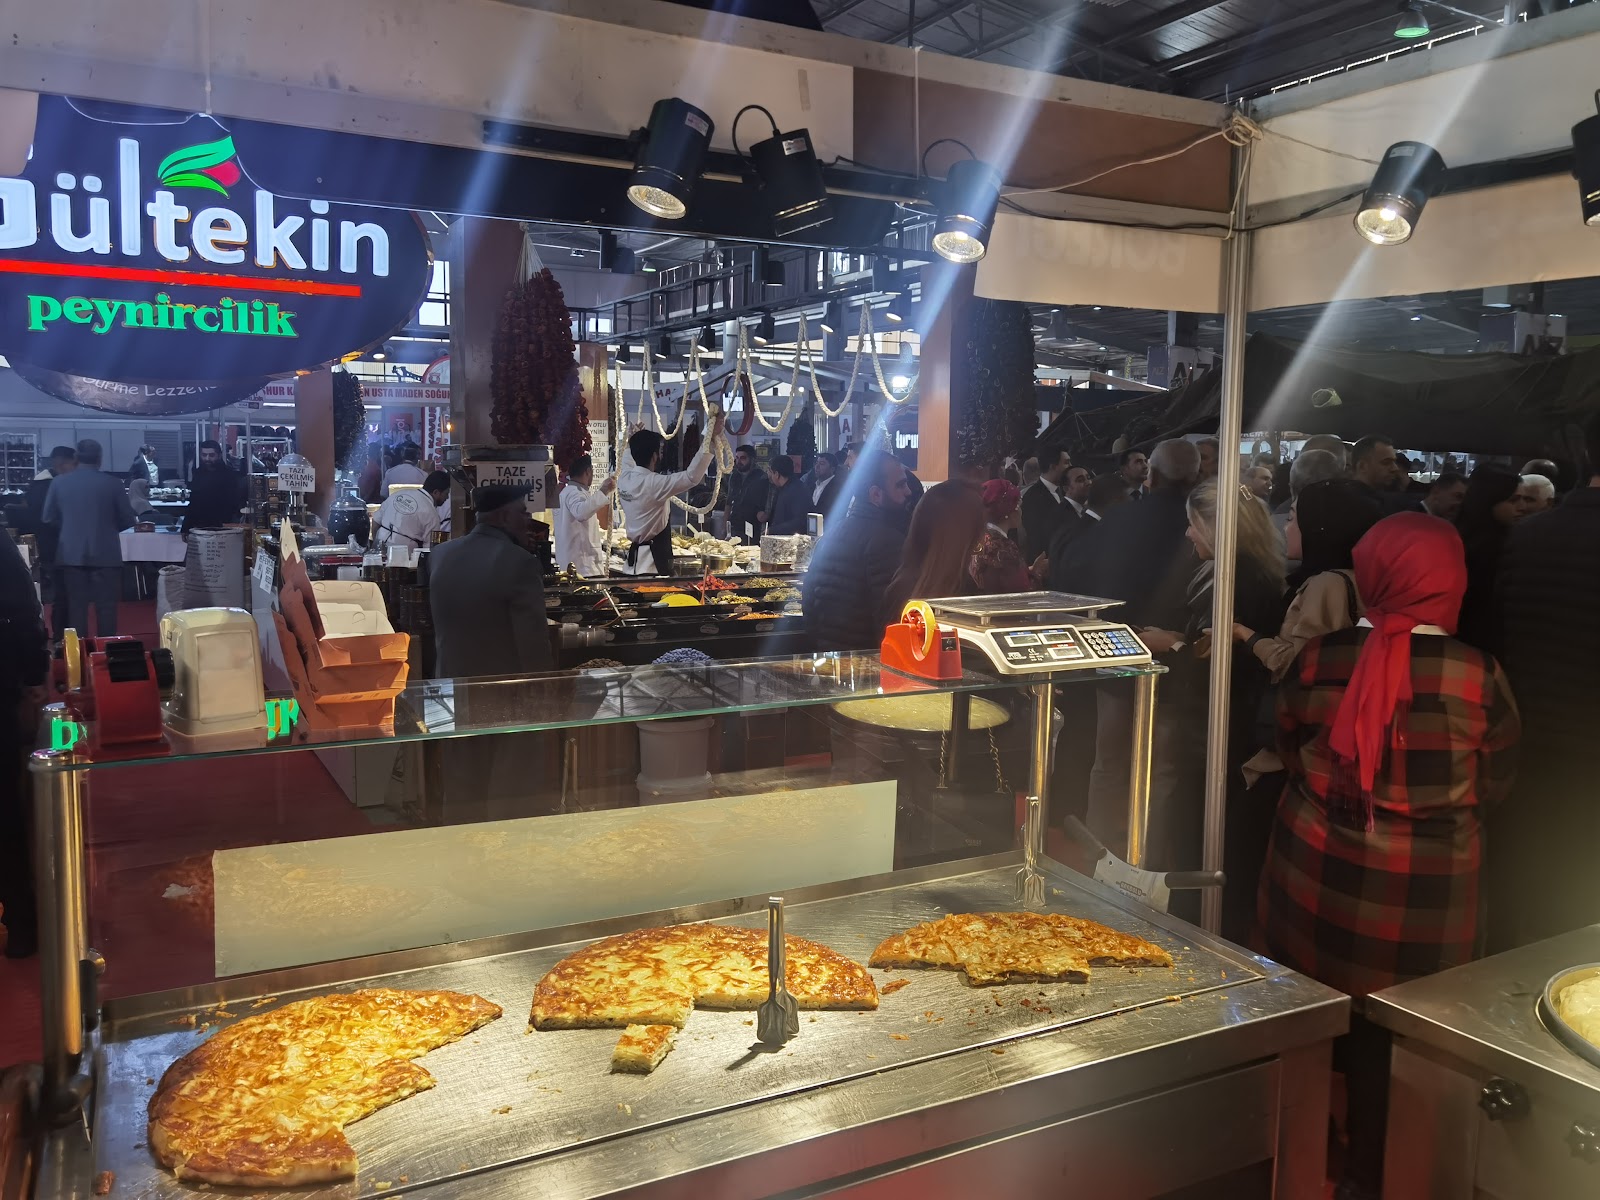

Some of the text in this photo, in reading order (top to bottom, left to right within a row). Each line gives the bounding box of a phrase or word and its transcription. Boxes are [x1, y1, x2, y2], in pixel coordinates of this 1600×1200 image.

[27, 293, 299, 338] peynircilik
[372, 388, 393, 398] USTA
[395, 388, 423, 398] MADEN
[496, 466, 526, 477] TAZE
[280, 473, 315, 483] ÇEKİLMİŞ
[285, 480, 309, 488] TAHİN
